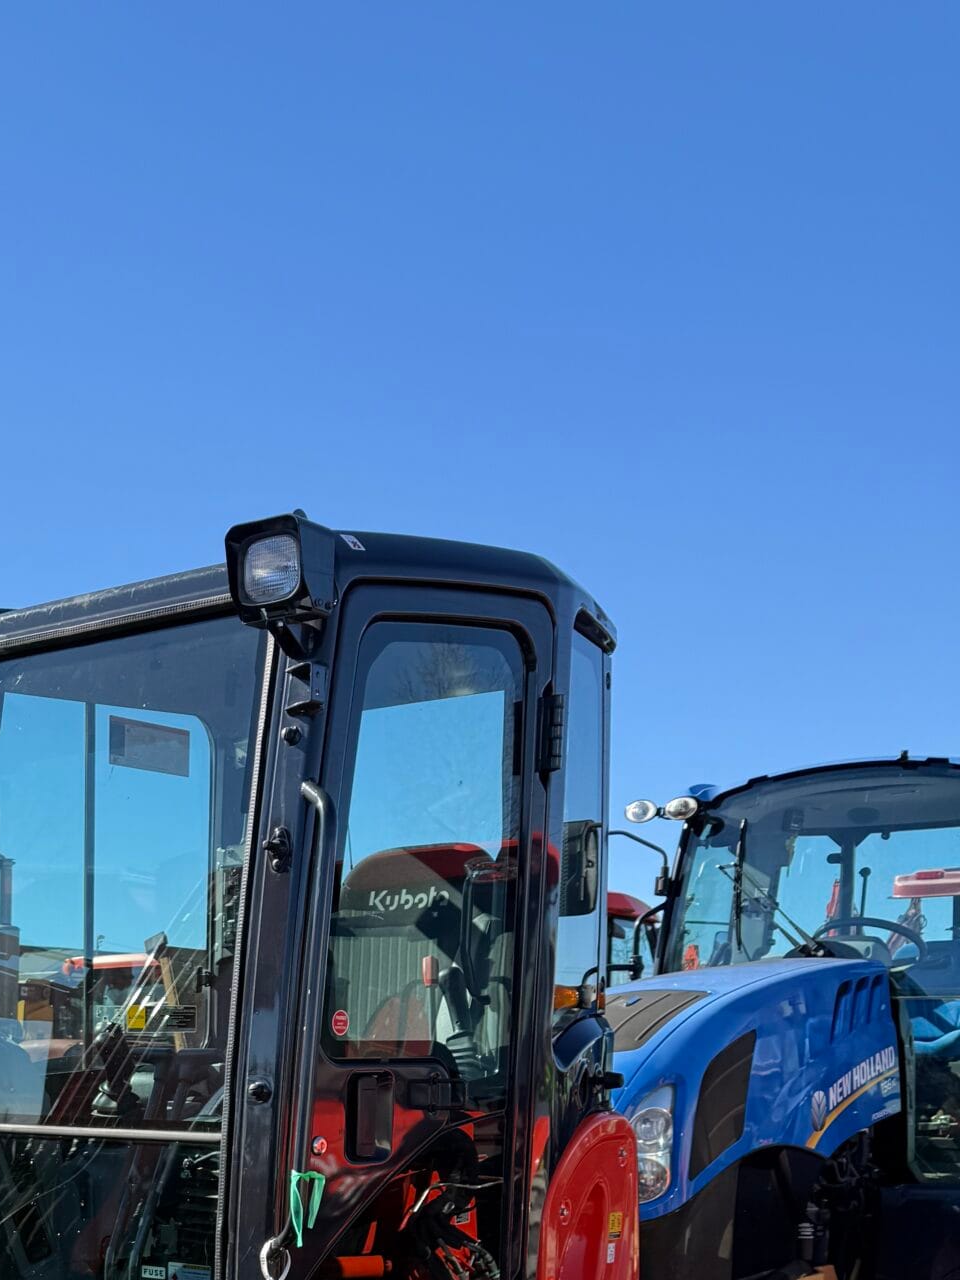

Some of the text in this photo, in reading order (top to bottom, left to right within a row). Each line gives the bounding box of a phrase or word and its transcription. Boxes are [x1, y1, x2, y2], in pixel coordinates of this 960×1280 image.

[368, 886, 450, 911] Kubota
[828, 1070, 853, 1111] NEW
[852, 1045, 896, 1090] HOLLAND
[143, 1268, 165, 1277] FUSE
